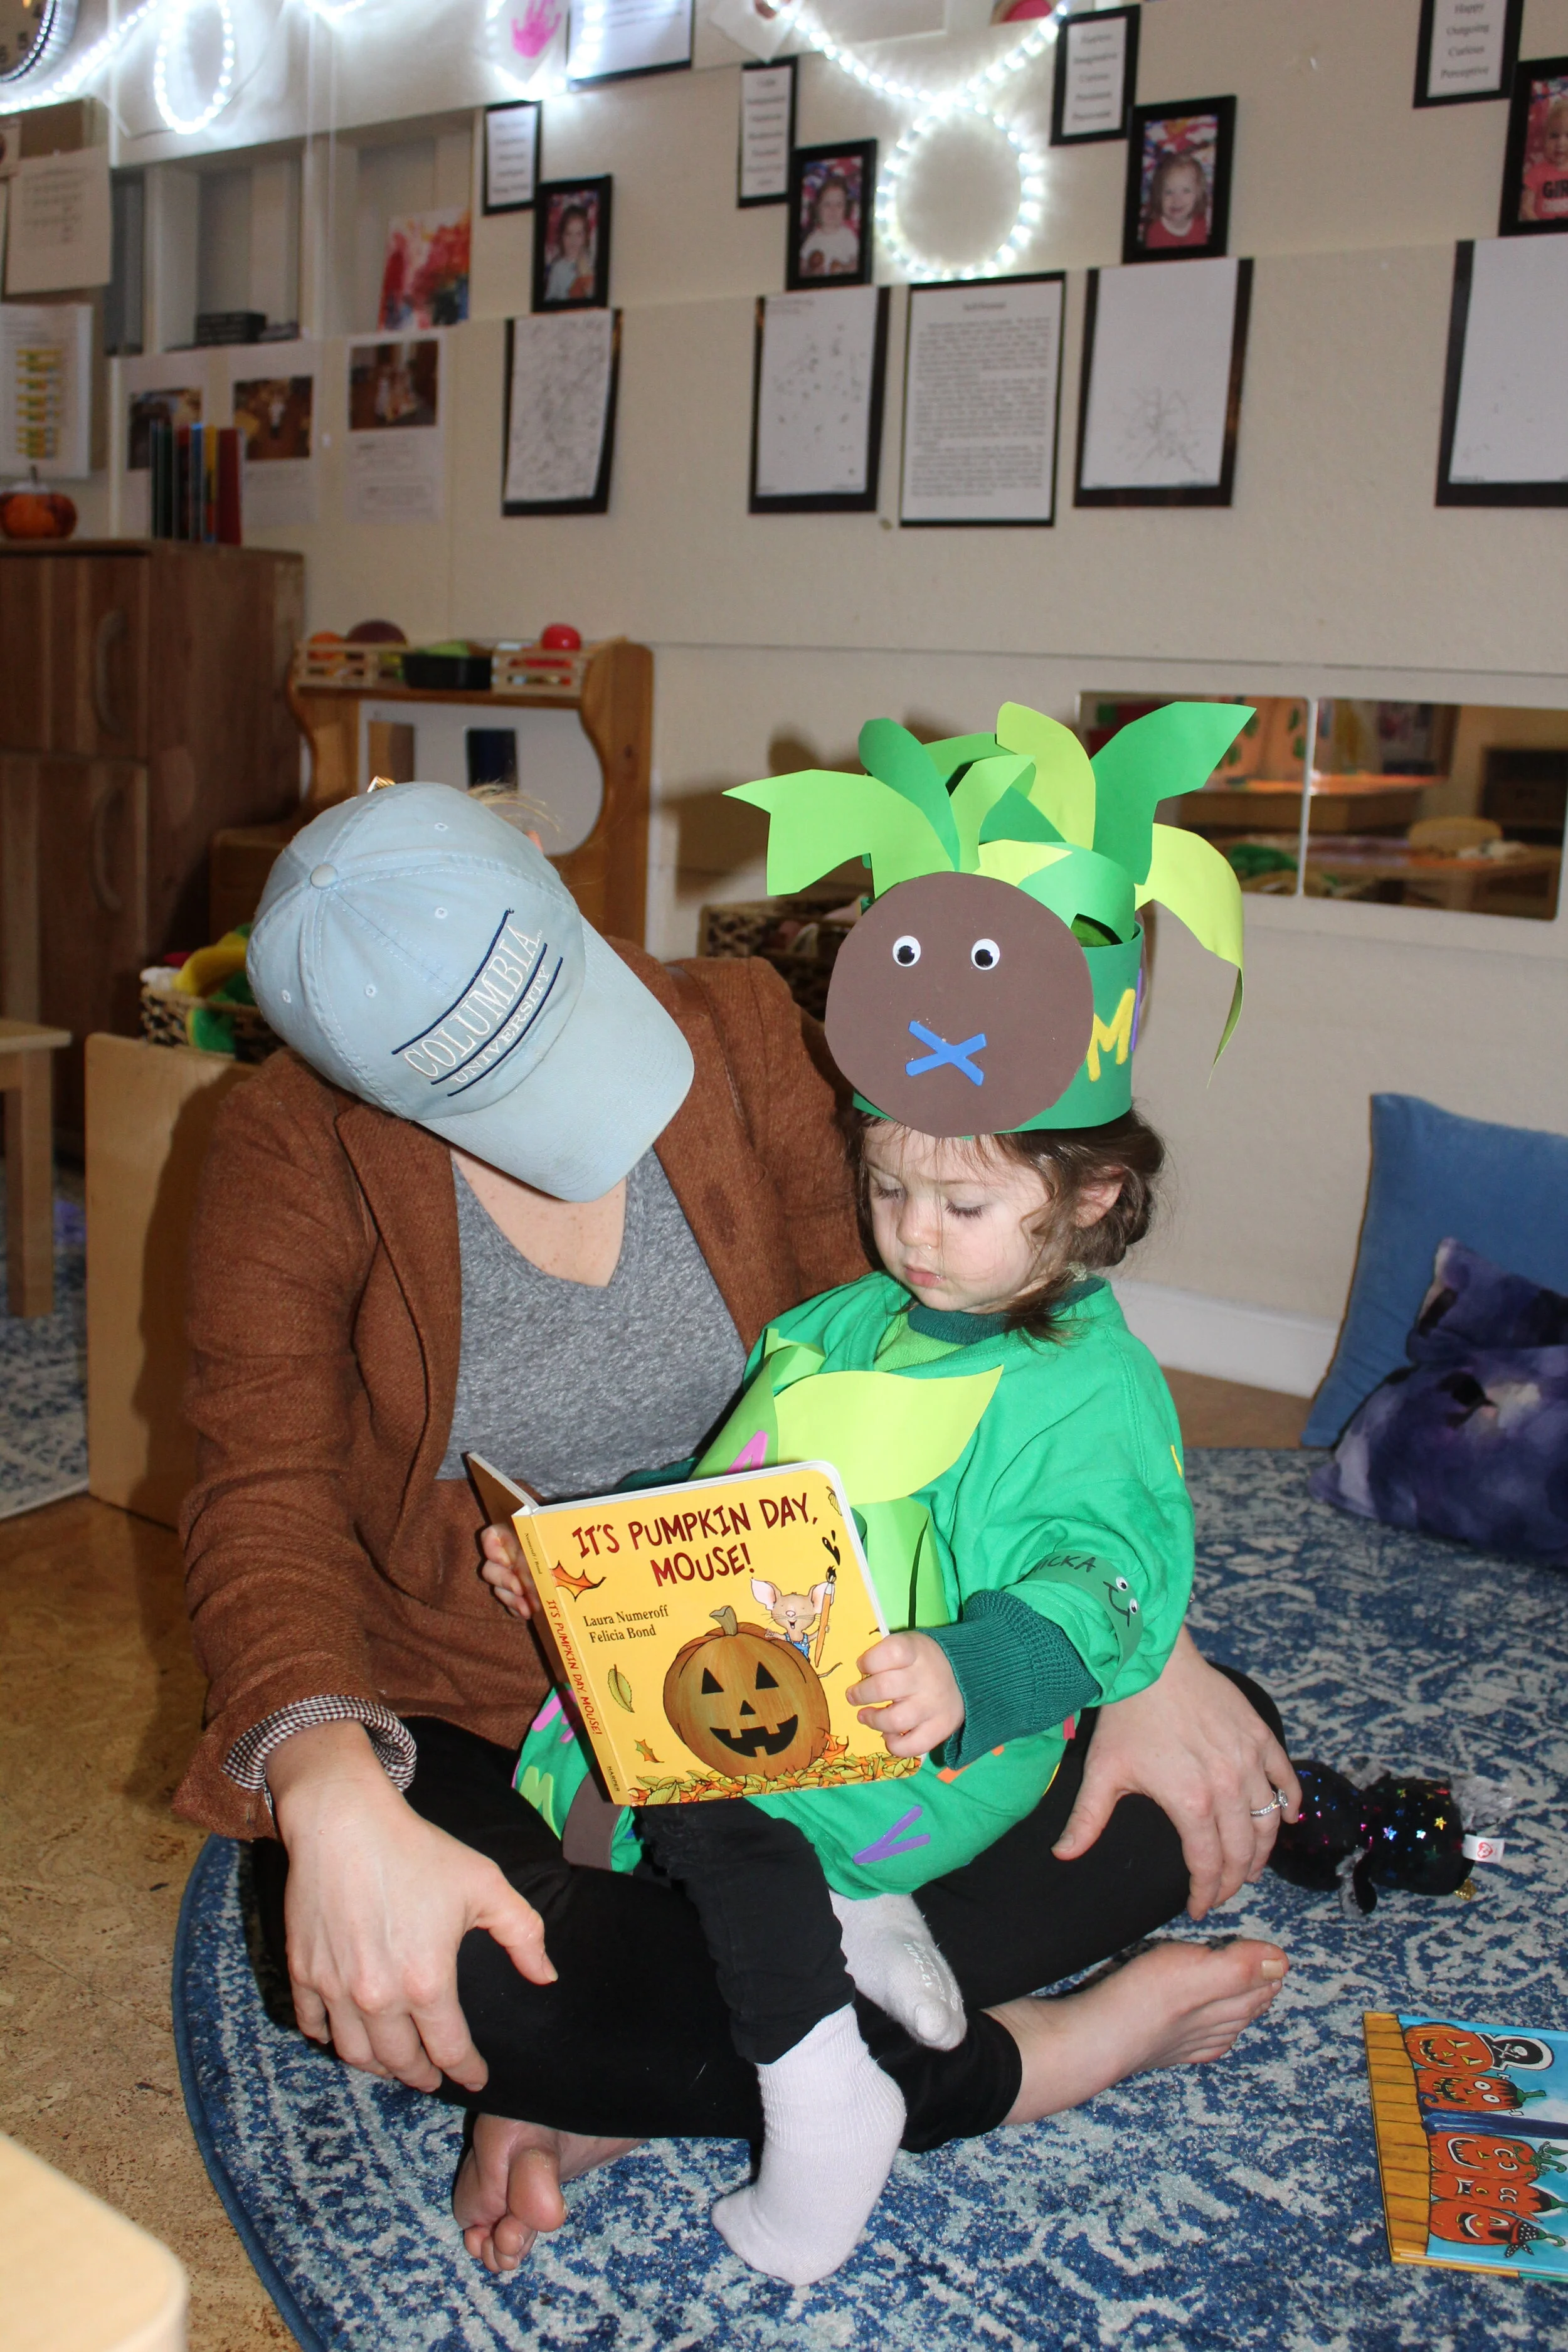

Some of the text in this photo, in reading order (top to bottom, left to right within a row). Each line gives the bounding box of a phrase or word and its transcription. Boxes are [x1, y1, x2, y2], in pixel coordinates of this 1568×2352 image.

[403, 925, 539, 1078] COLUMBIA
[451, 965, 551, 1083] UNIVERSITY
[572, 1493, 818, 1559] IT'S PUMPKIN DAY,
[524, 1533, 536, 1557] Numeroff
[534, 1561, 543, 1575] Bond
[650, 1542, 755, 1587] MOUSE!
[1033, 1555, 1096, 1573] ICKA
[583, 1604, 669, 1627] Laura Numeroff
[589, 1624, 657, 1643] Felicia Bond
[546, 1600, 561, 1618] IT'S
[554, 1623, 579, 1670] PUMPKIN
[580, 1696, 603, 1735] MOUSE!
[607, 1766, 620, 1792] HARPER
